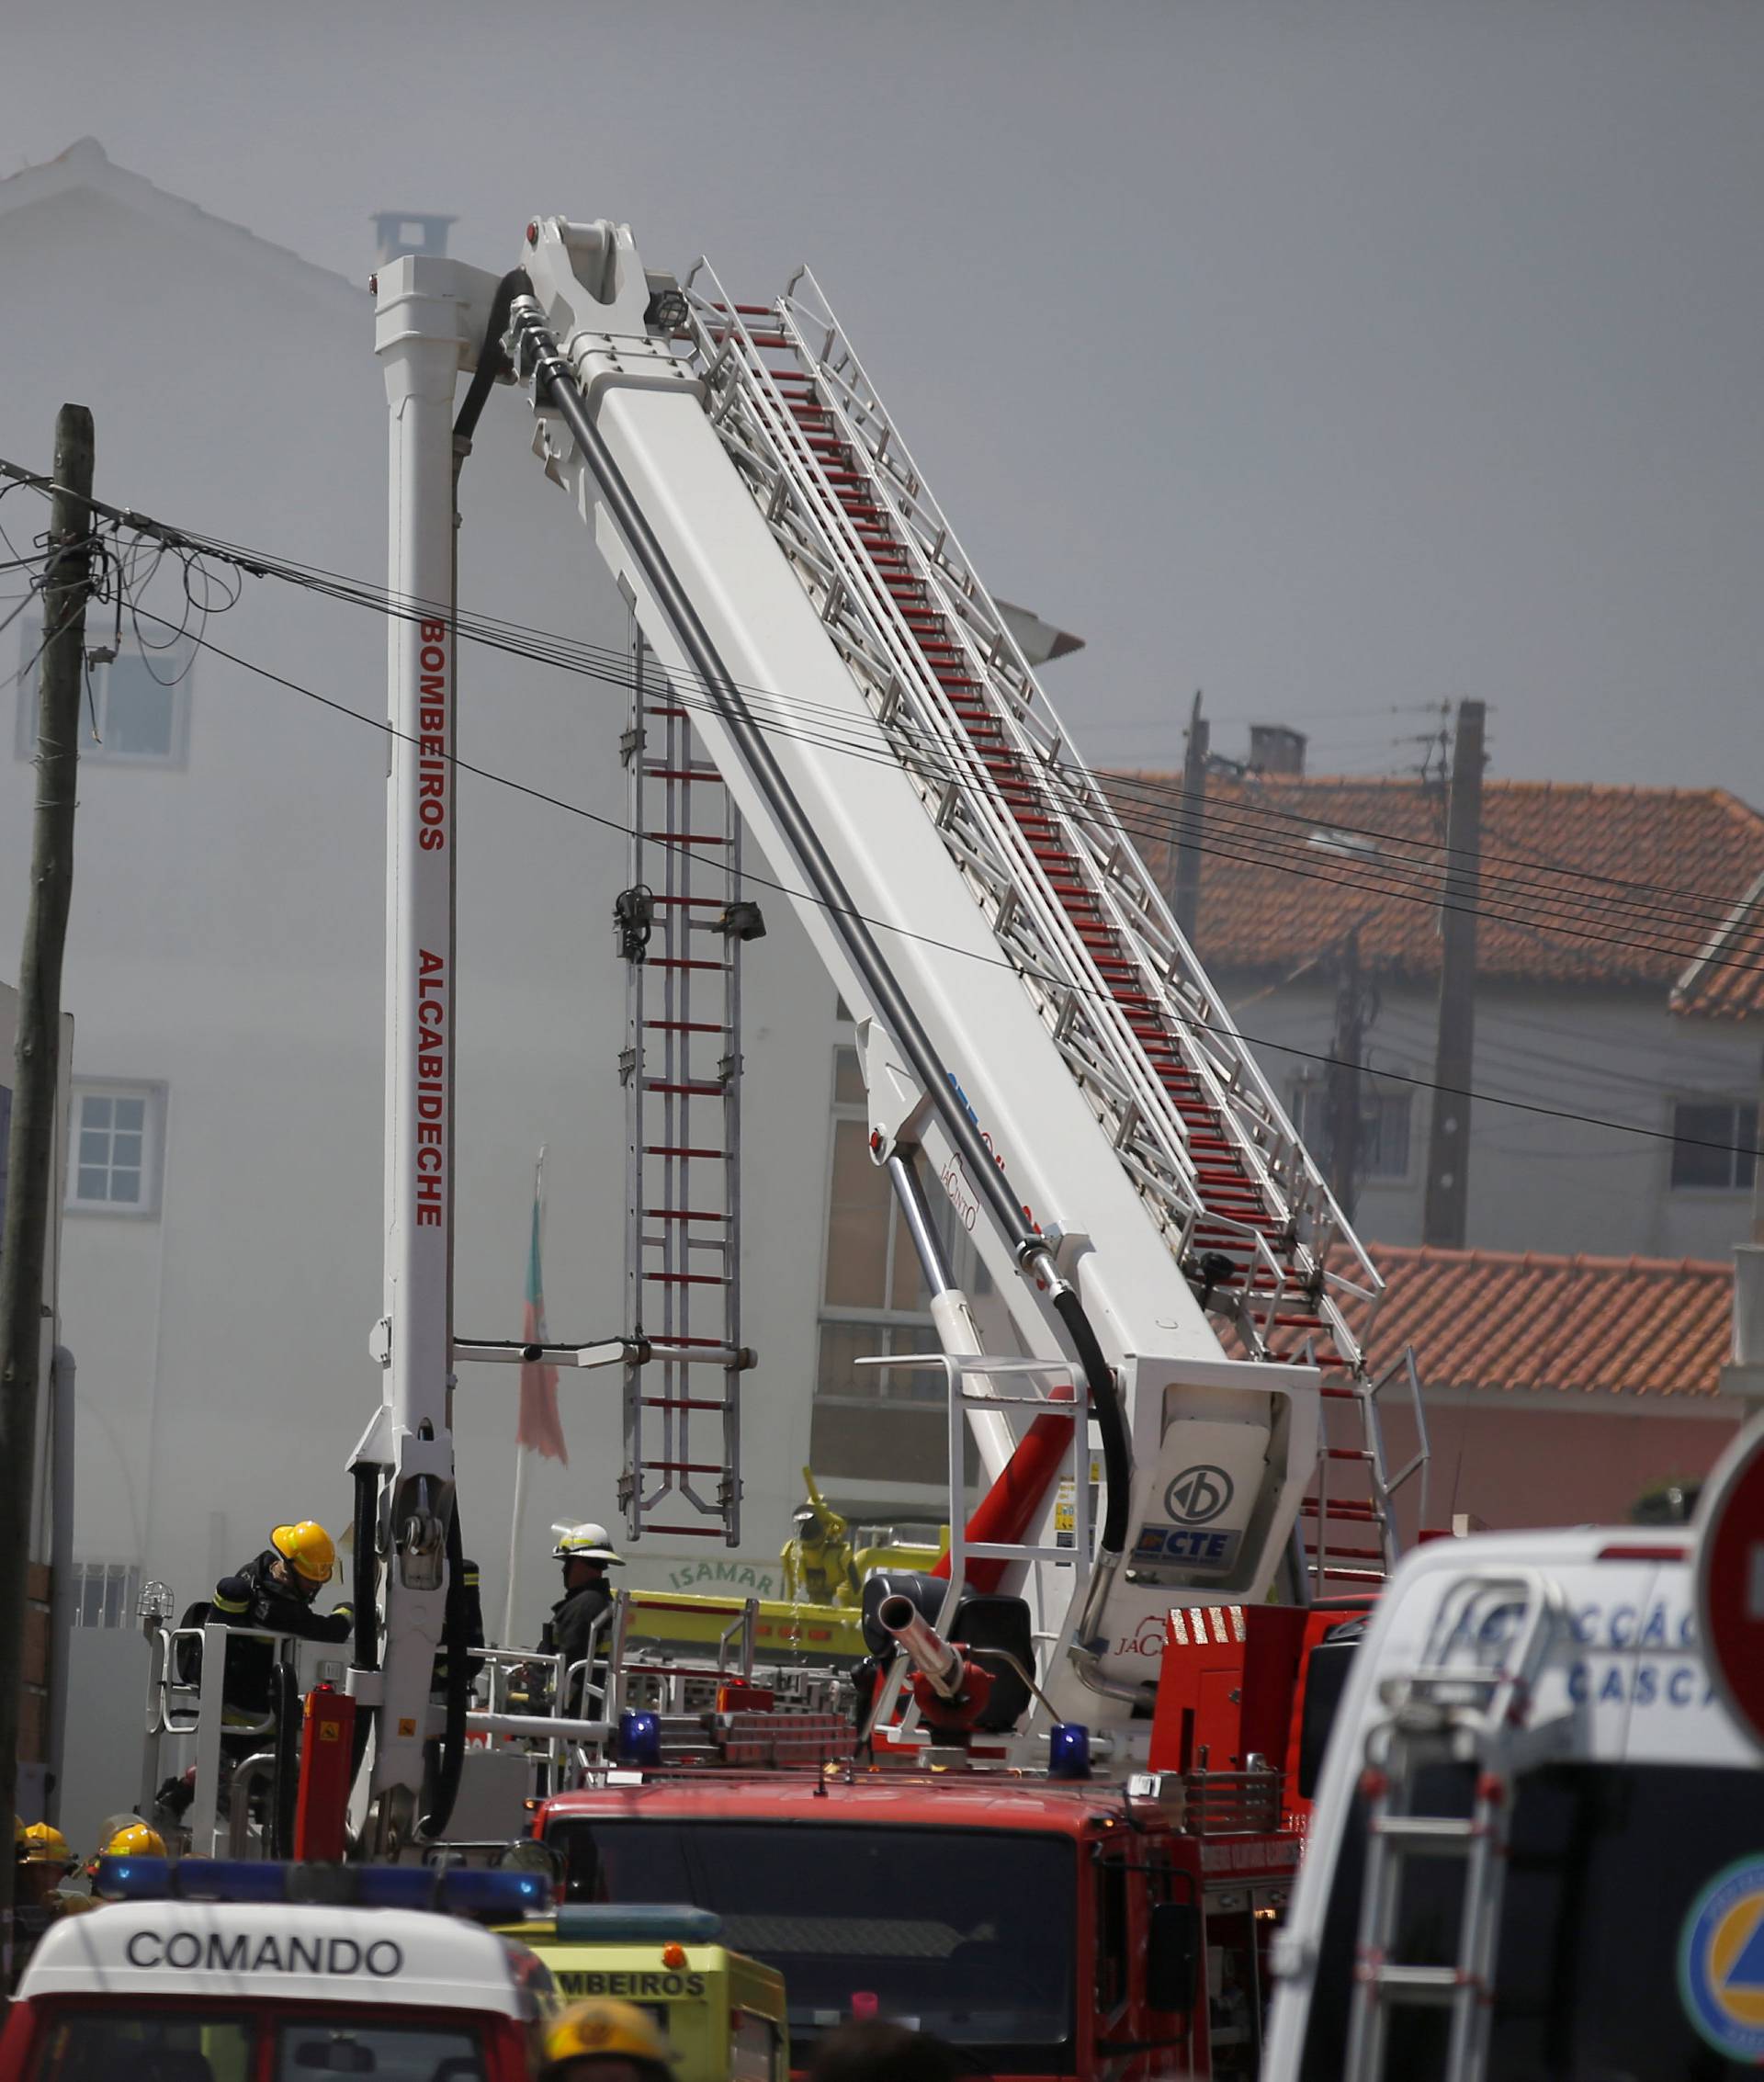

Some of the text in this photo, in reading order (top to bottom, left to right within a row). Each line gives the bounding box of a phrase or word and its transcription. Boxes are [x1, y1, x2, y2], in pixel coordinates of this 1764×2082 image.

[417, 619, 445, 1227] BOMBEIROS ALCABIDECHE
[1167, 1531, 1228, 1556] CTE
[669, 1562, 774, 1595] ISAMAR
[1114, 1634, 1163, 1658] JAC
[1568, 1662, 1719, 1705] CASC
[126, 1931, 403, 1976] COMANDO
